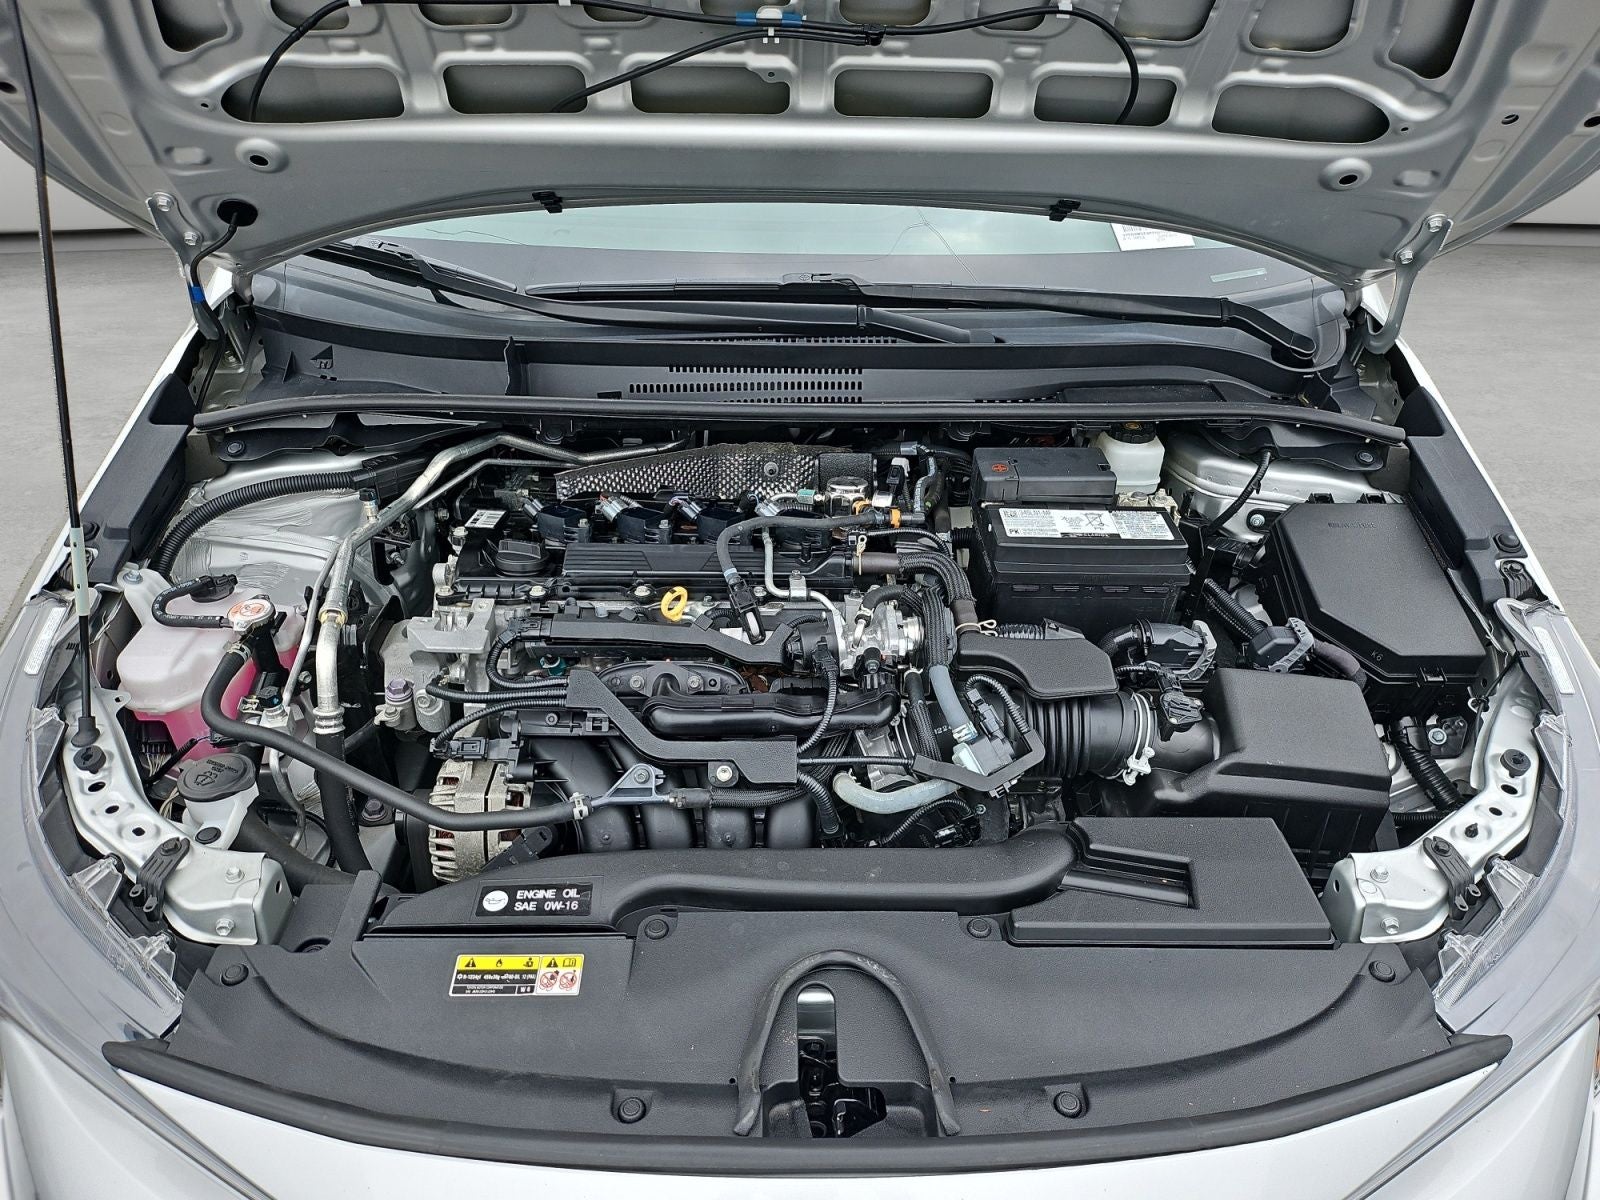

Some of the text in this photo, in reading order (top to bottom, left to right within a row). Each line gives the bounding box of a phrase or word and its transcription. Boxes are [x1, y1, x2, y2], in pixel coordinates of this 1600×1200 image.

[516, 888, 580, 900] ENGINE OIL
[514, 901, 579, 911] SAE 0W-16
